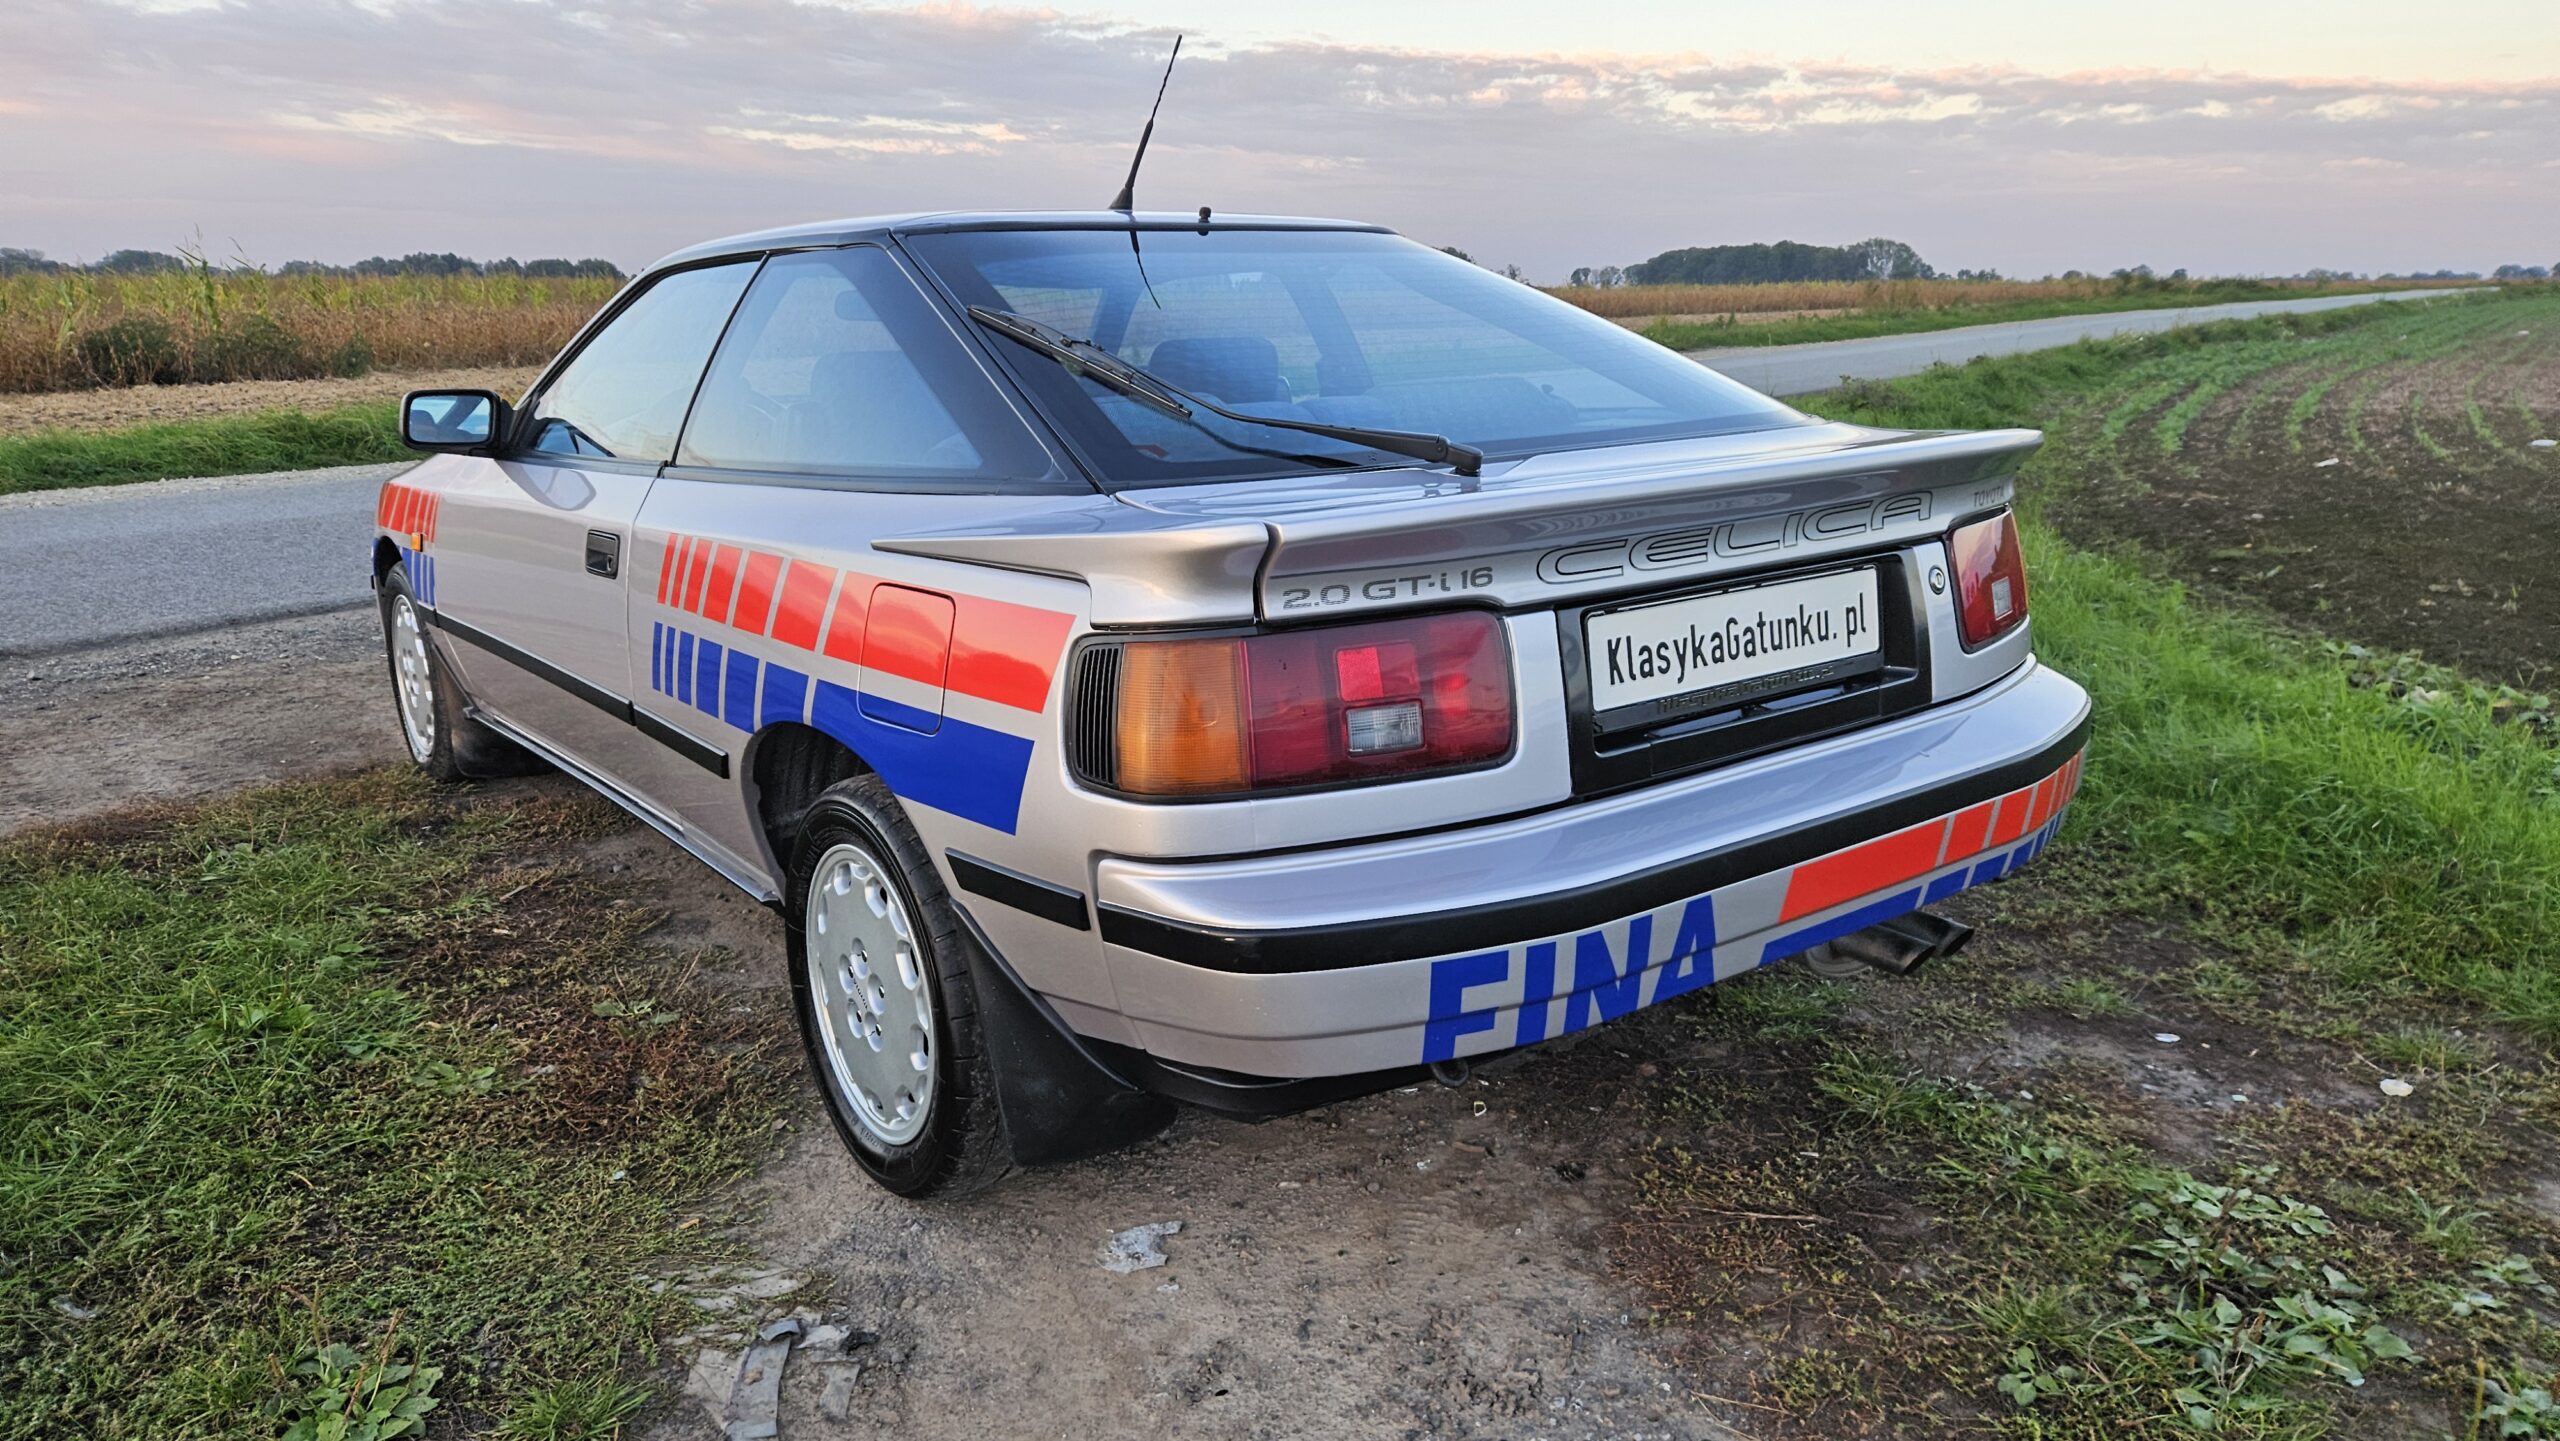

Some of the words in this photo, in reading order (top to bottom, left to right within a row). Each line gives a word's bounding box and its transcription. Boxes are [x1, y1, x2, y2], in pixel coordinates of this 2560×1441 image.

[1535, 490, 1933, 585] CELICA
[1282, 584, 1350, 610] 2.0
[1422, 894, 1717, 1064] FINA
